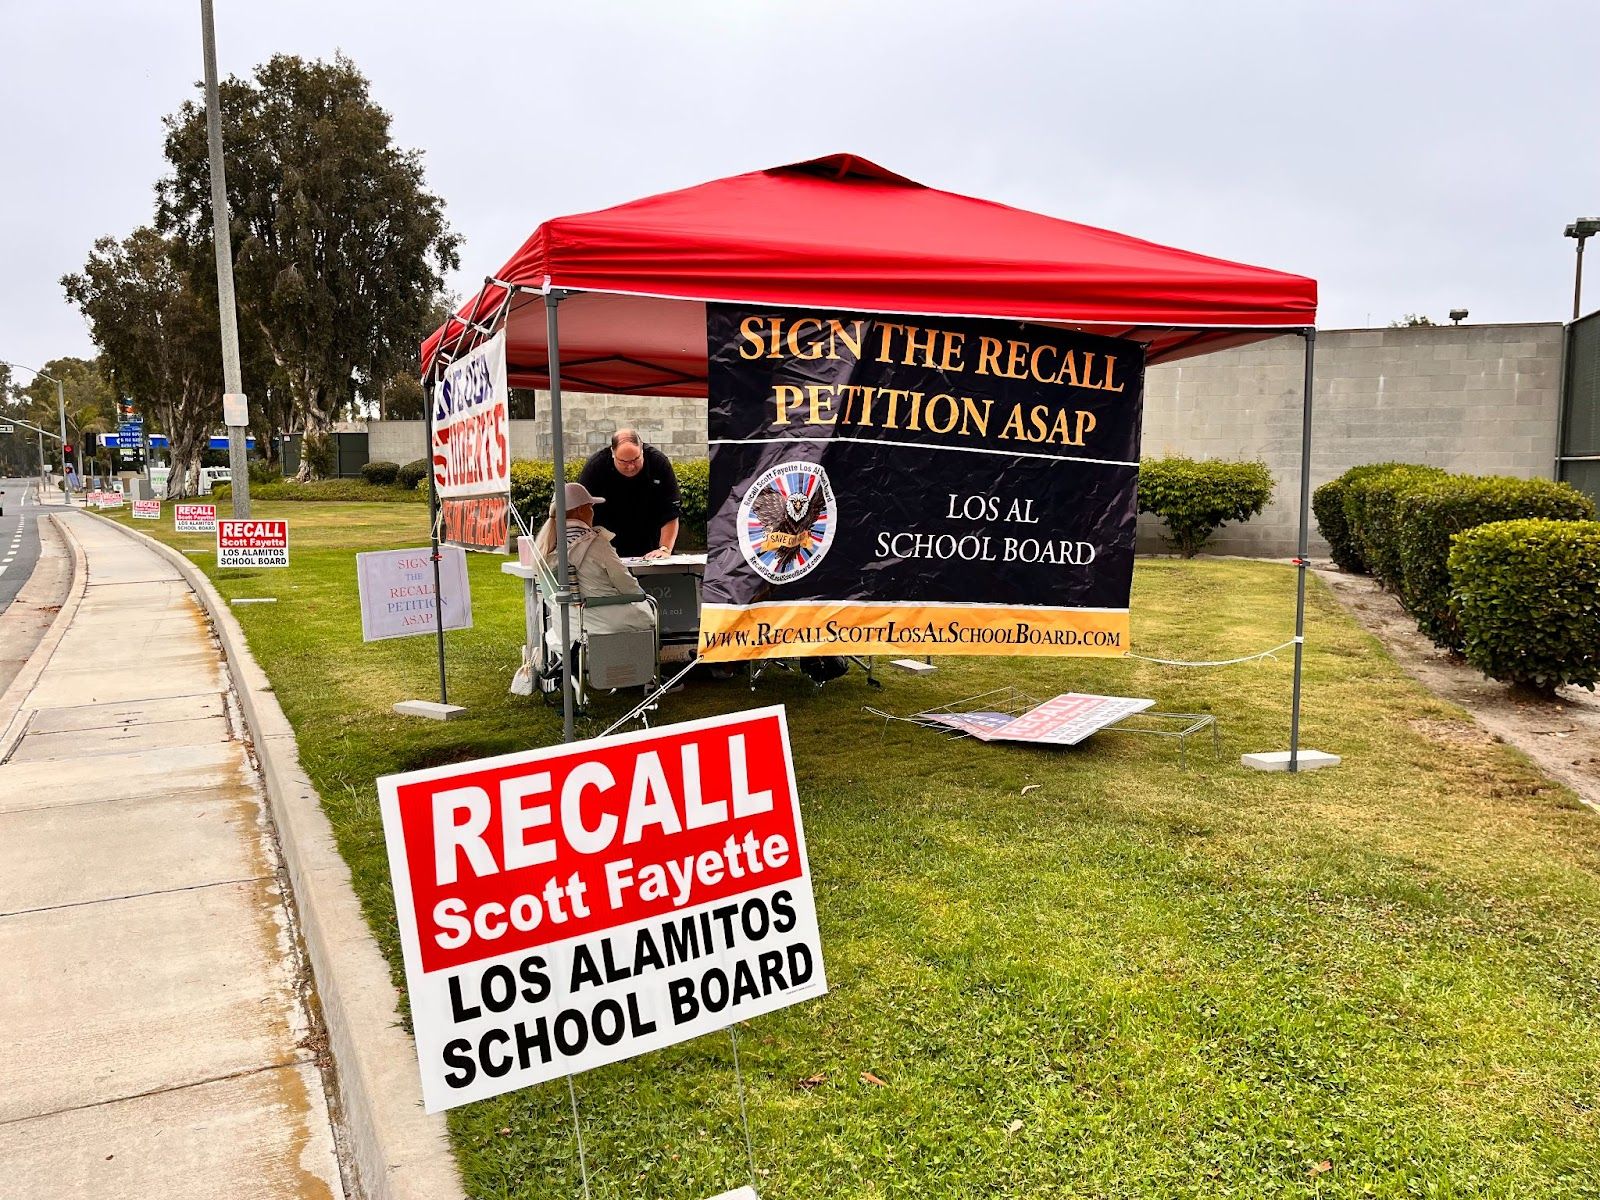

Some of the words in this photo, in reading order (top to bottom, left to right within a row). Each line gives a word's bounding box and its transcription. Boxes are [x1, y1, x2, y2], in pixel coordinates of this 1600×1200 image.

[739, 317, 864, 360] SIGN
[873, 323, 964, 373] THE
[975, 337, 1124, 392] RECALL
[772, 385, 994, 436] PETITION
[1000, 404, 1097, 446] ASAP
[744, 486, 759, 506] Recall
[758, 473, 773, 488] Scott
[772, 465, 798, 477] Fayette
[799, 464, 811, 472] Los
[178, 506, 213, 515] RECALL
[946, 494, 1000, 521] LOS
[1005, 498, 1039, 524] AL
[221, 538, 248, 546] Scott
[250, 538, 285, 548] Fayette
[223, 523, 283, 537] RECALL
[770, 534, 787, 543] SAVE
[398, 557, 429, 570] SIGN
[875, 532, 996, 561] SCHOOL
[1003, 538, 1096, 566] BOARD
[405, 573, 423, 581] THE
[402, 614, 433, 626] ASAP
[1005, 696, 1086, 734] RECALL
[432, 734, 774, 886] RECALL
[433, 870, 591, 950] Scott
[605, 829, 790, 908] Fayette
[448, 956, 552, 1024] LOS
[569, 890, 796, 993] ALAMITOS
[442, 993, 657, 1089] SCHOOL
[669, 942, 814, 1026] BOARD
